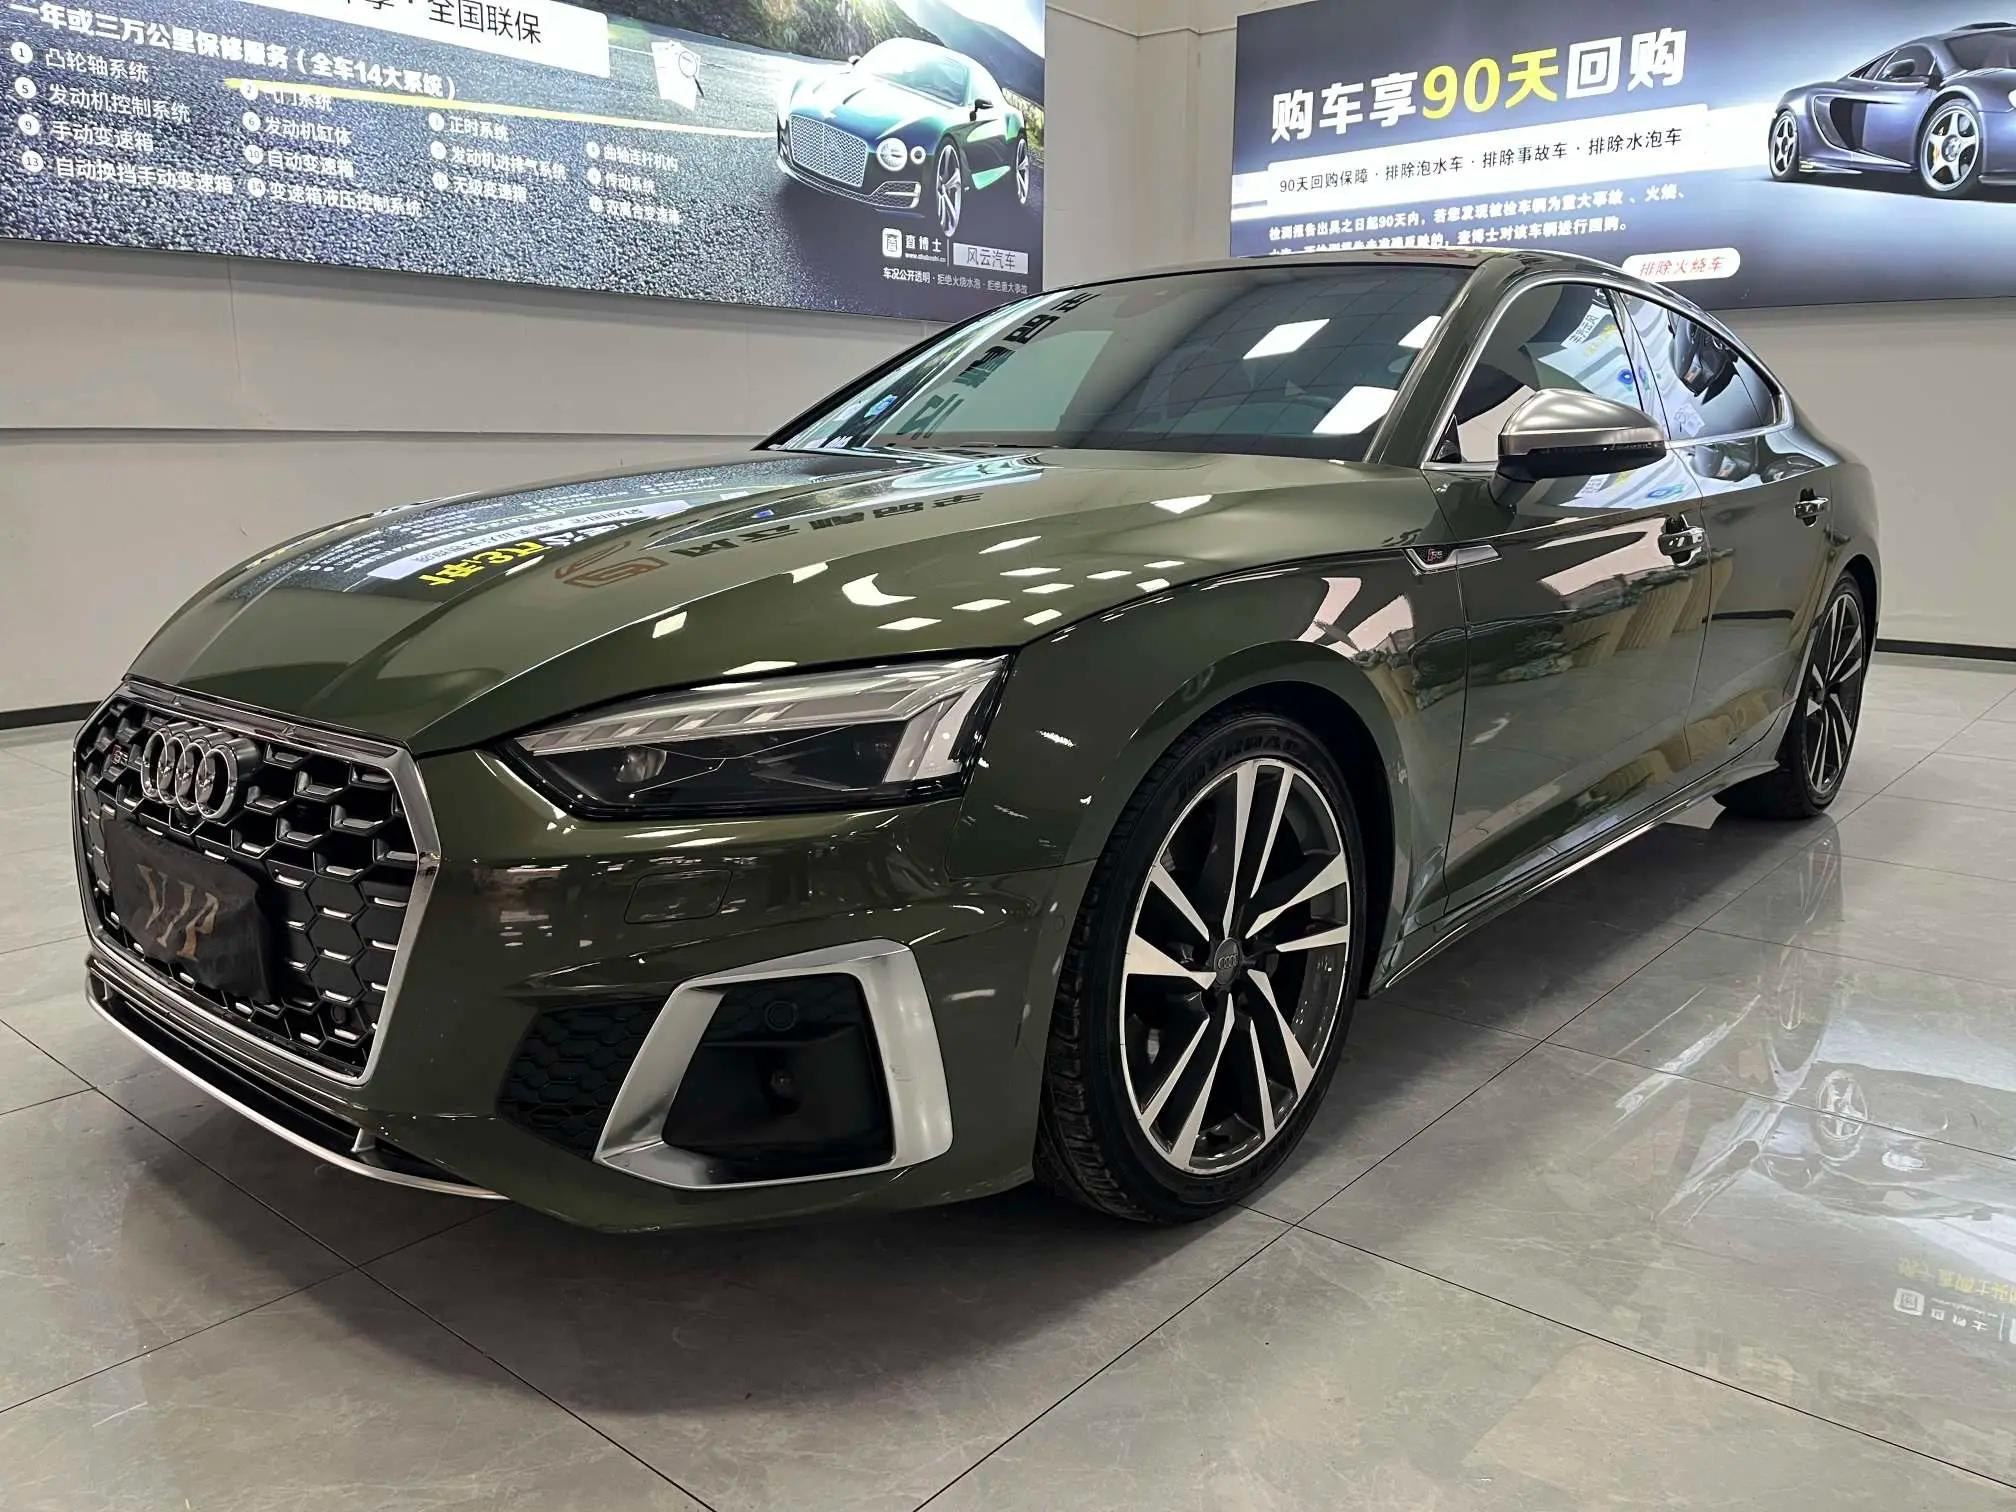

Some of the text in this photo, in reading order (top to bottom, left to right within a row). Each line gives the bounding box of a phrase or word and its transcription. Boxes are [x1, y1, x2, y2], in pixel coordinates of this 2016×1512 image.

[46, 49, 149, 83] 凸轮轴系统
[1271, 27, 1687, 144] 购车享90天回购
[50, 84, 191, 124] 发动机控制系统
[51, 121, 153, 152] 手动变速箱
[264, 116, 352, 147] 发动机缸体
[56, 157, 233, 194] 自动换挡手动变速箱
[268, 150, 354, 178] 自动变速箱
[967, 247, 1016, 270] 风云汽车
